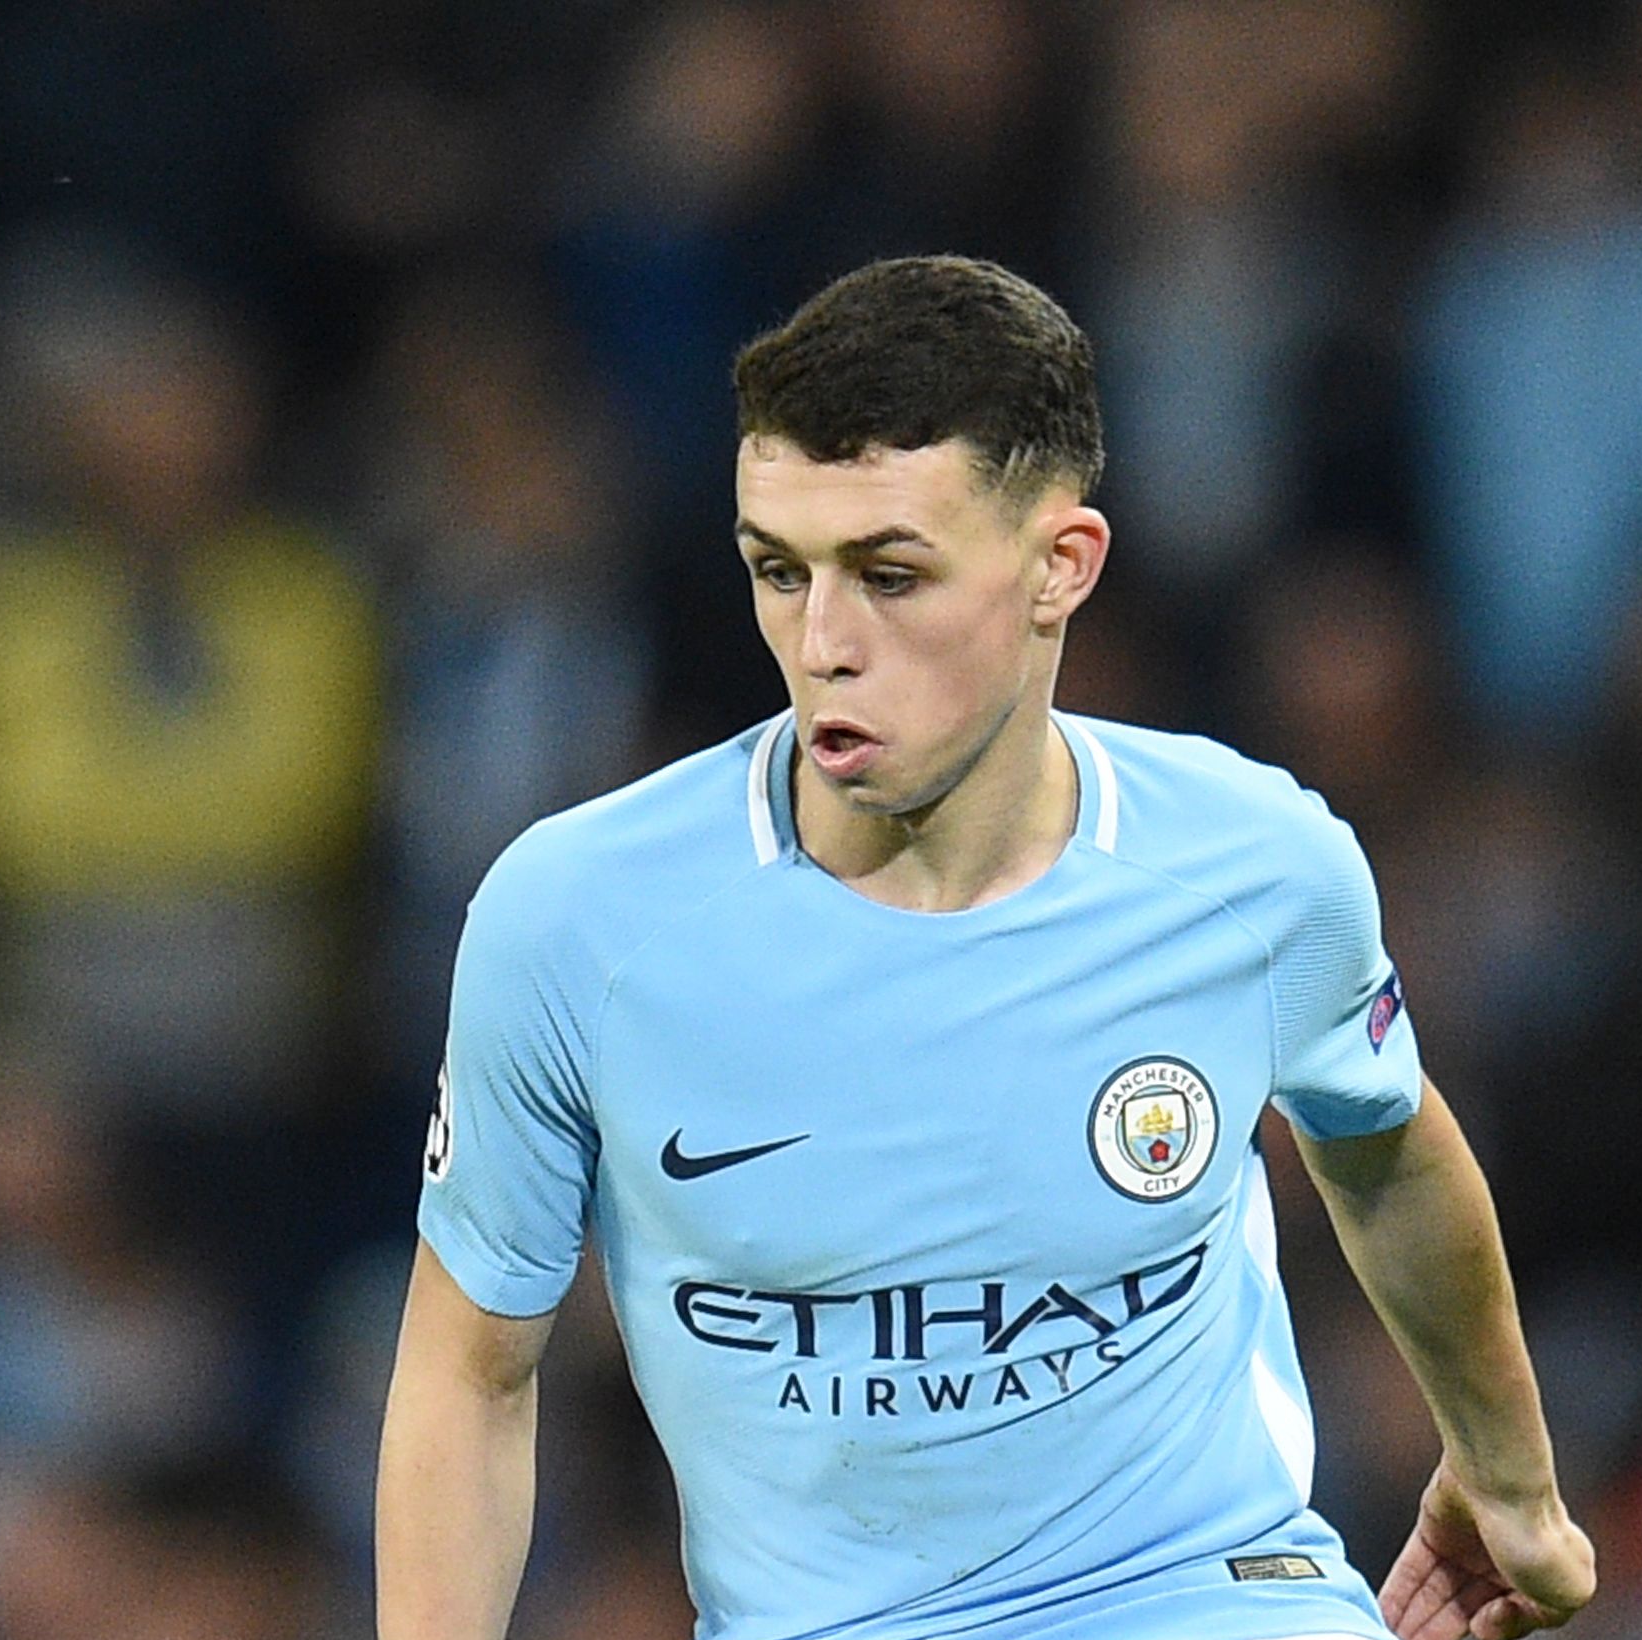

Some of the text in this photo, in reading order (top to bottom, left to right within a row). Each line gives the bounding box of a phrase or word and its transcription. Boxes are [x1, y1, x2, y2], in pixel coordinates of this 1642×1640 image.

[1104, 1068, 1204, 1118] MANCHESTER
[1143, 1176, 1181, 1192] CITY
[672, 1243, 1211, 1360] ETIHAD
[779, 1341, 1124, 1417] AIRWAYS
